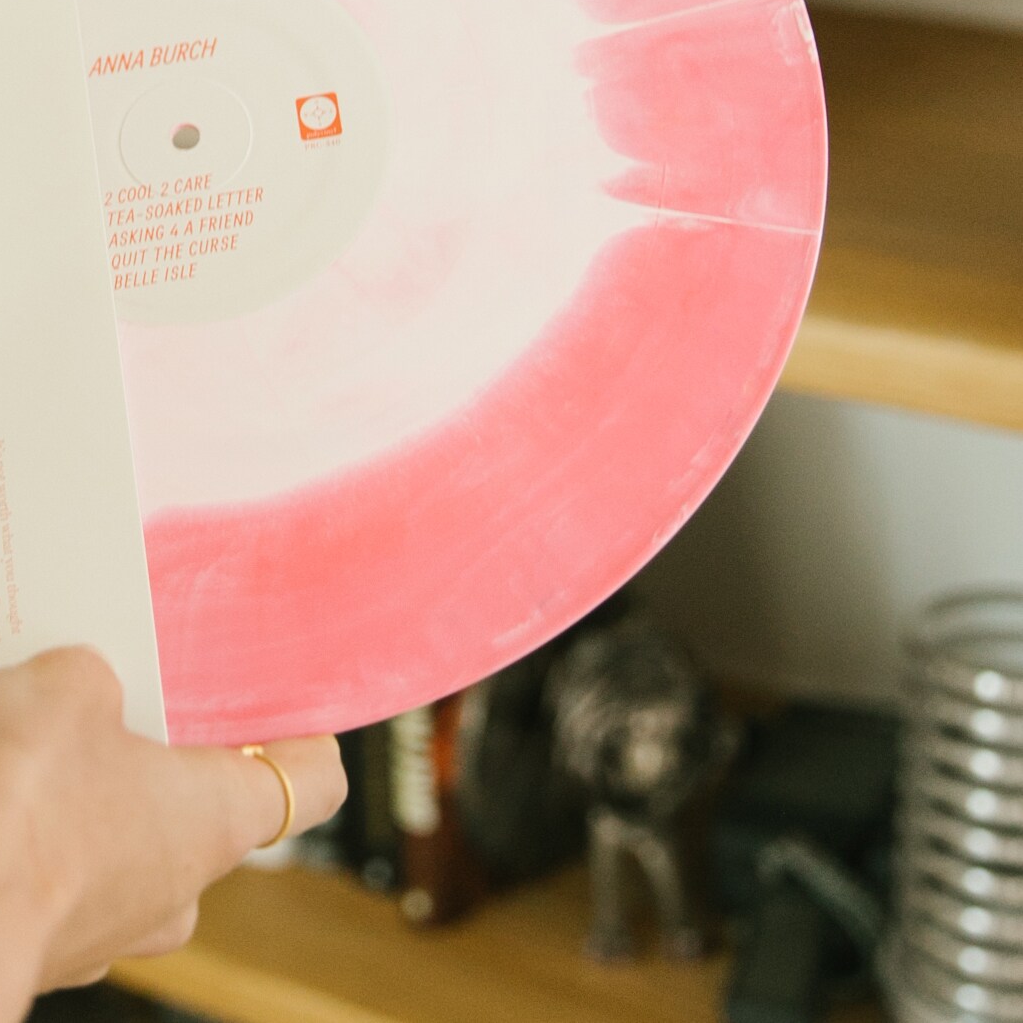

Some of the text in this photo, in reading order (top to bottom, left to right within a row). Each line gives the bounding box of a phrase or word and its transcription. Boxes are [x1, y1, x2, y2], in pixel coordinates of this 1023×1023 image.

[88, 37, 218, 78] ANNA BURCH
[104, 173, 213, 207] 2 COOL 2 CARE
[107, 186, 264, 227] TEA-SOAKED LETTER
[108, 210, 255, 249] ASKING 4 A FRIEND
[111, 234, 240, 271] QUIT THE CURSE
[113, 263, 198, 291] BELLE ISLE
[1, 522, 13, 555] what
[0, 556, 14, 582] you
[6, 583, 22, 634] thought
